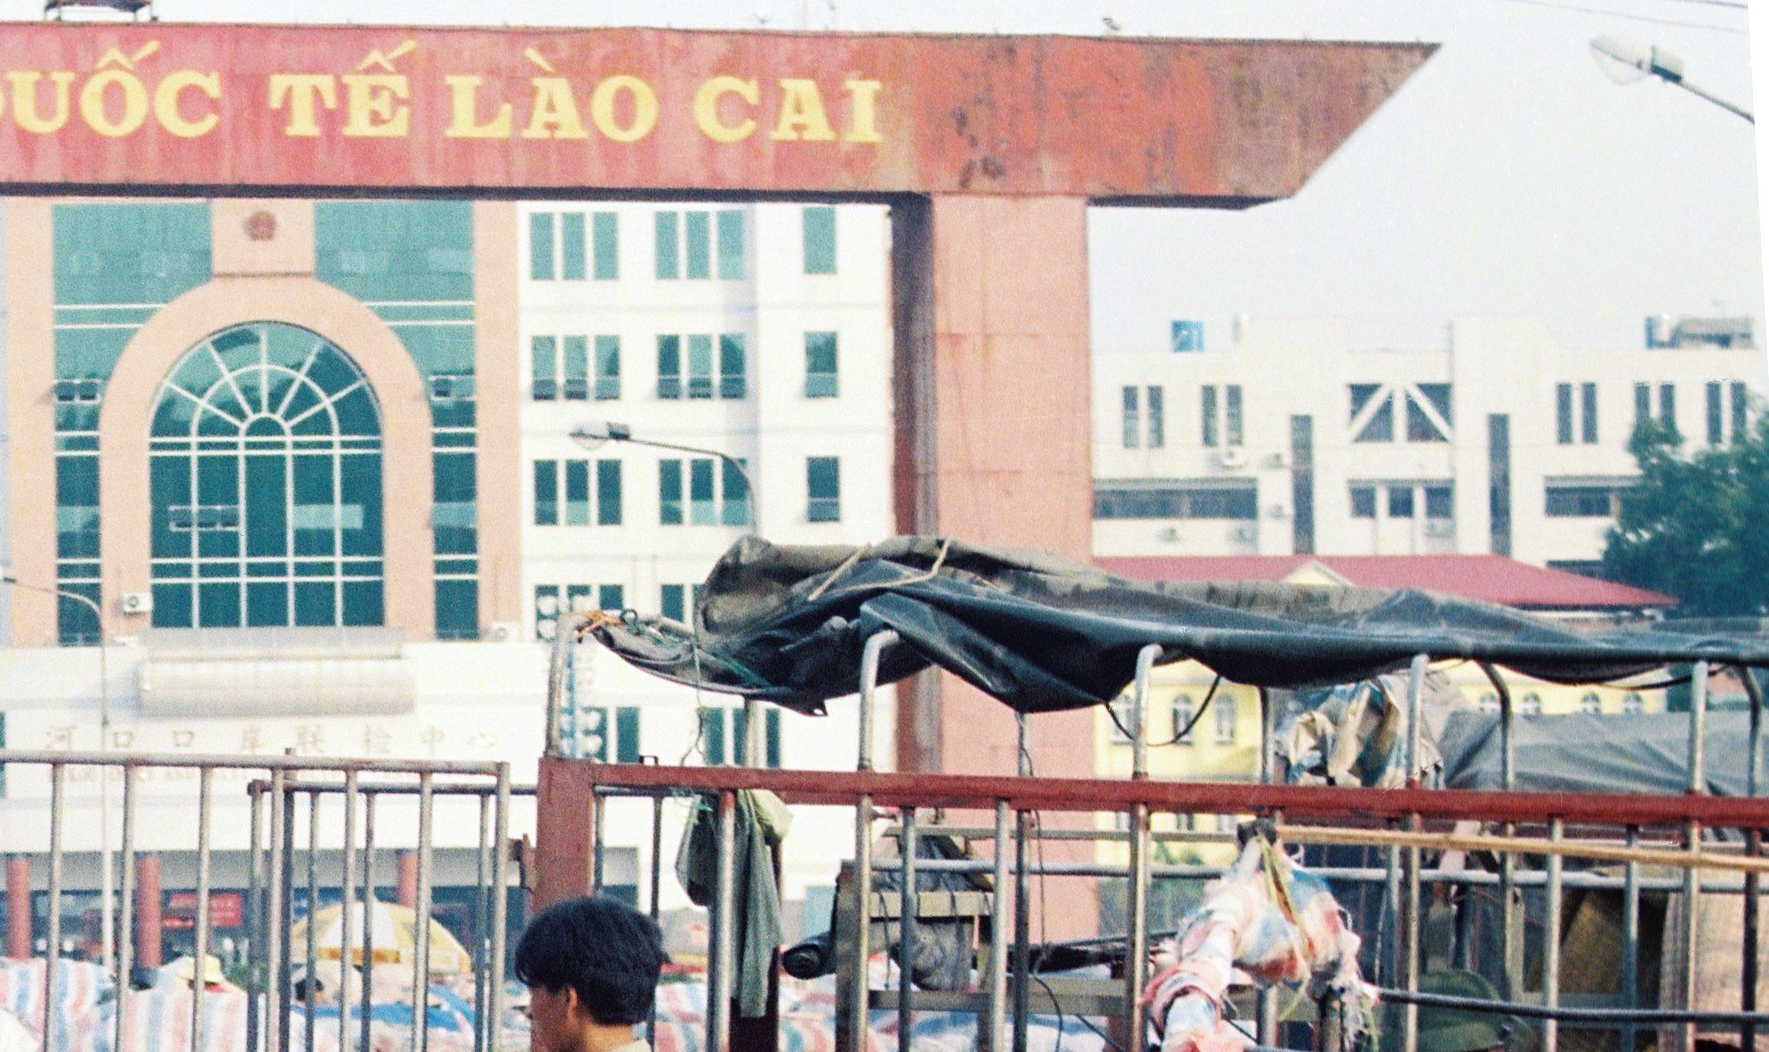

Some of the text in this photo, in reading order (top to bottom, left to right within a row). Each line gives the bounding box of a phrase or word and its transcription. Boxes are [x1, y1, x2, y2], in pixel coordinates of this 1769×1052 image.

[269, 40, 417, 138] TẾ
[445, 47, 659, 142] LÀO
[692, 76, 882, 143] CAI
